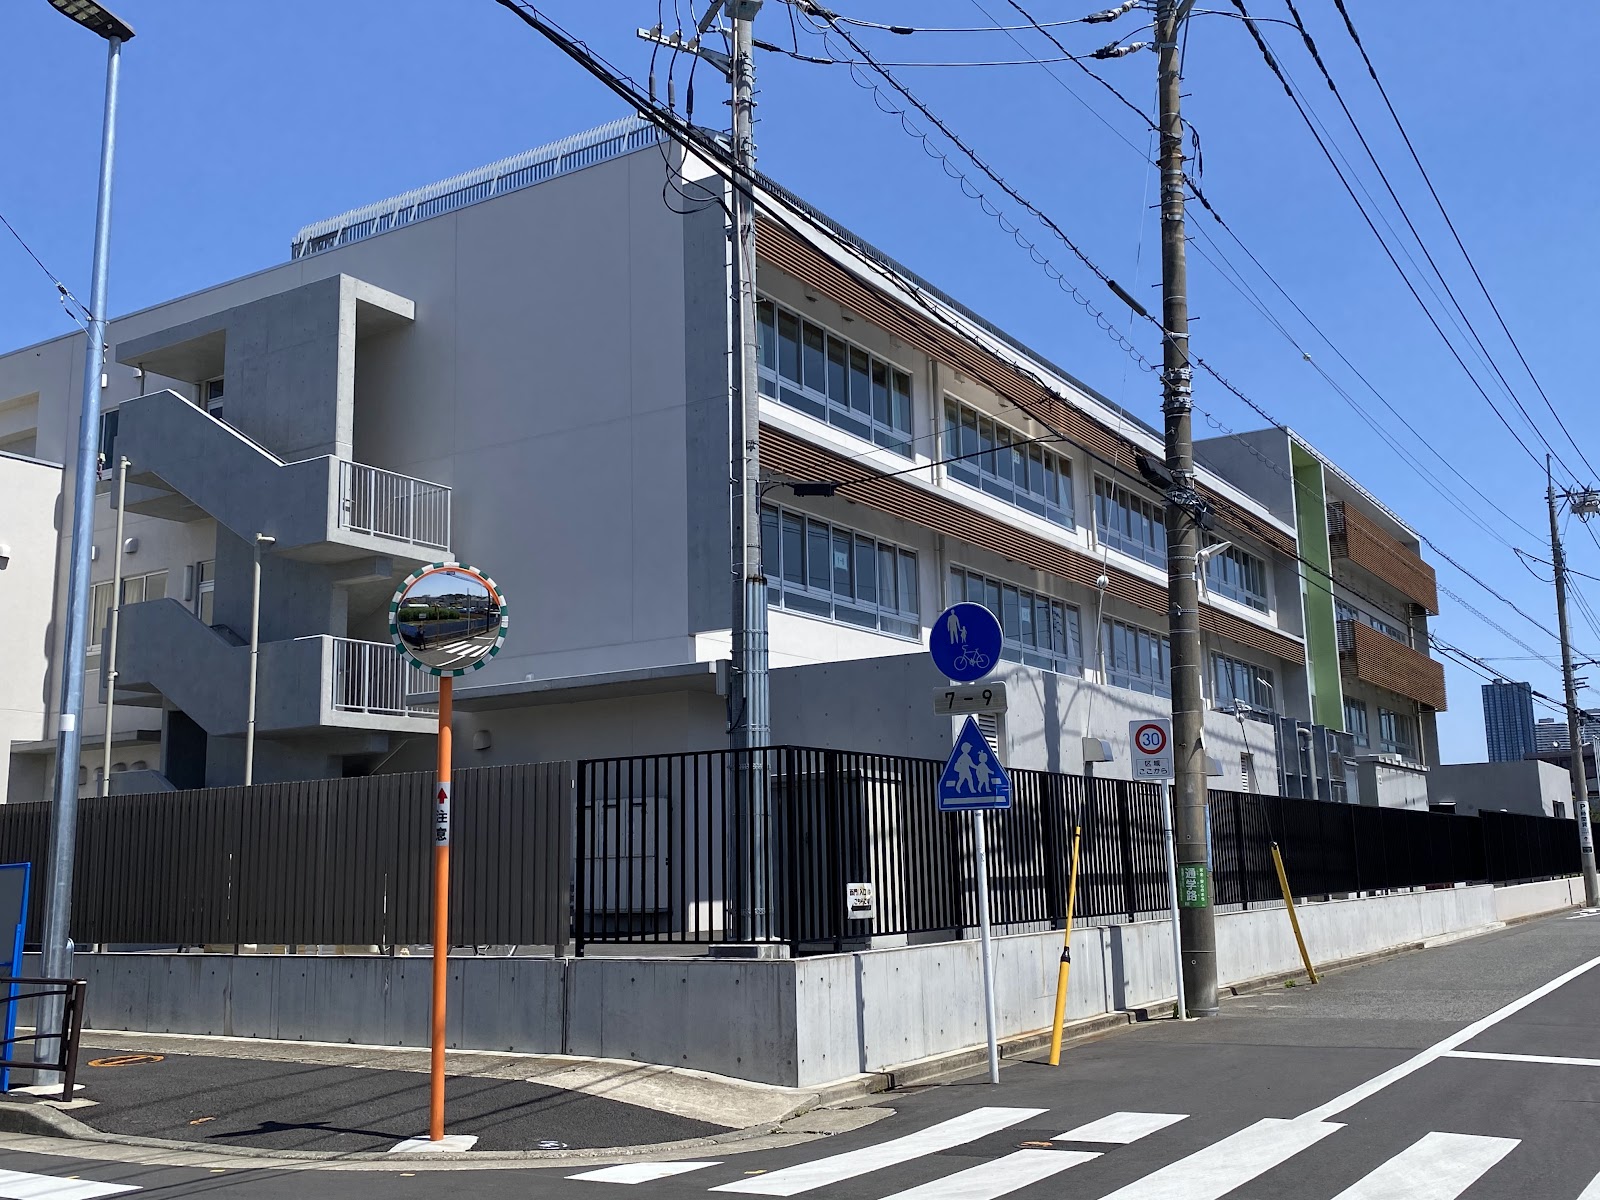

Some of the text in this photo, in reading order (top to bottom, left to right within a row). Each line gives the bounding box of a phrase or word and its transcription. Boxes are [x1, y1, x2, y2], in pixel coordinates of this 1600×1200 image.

[1142, 732, 1160, 747] 30
[436, 809, 448, 841] 注意
[1185, 867, 1197, 902] 通学路
